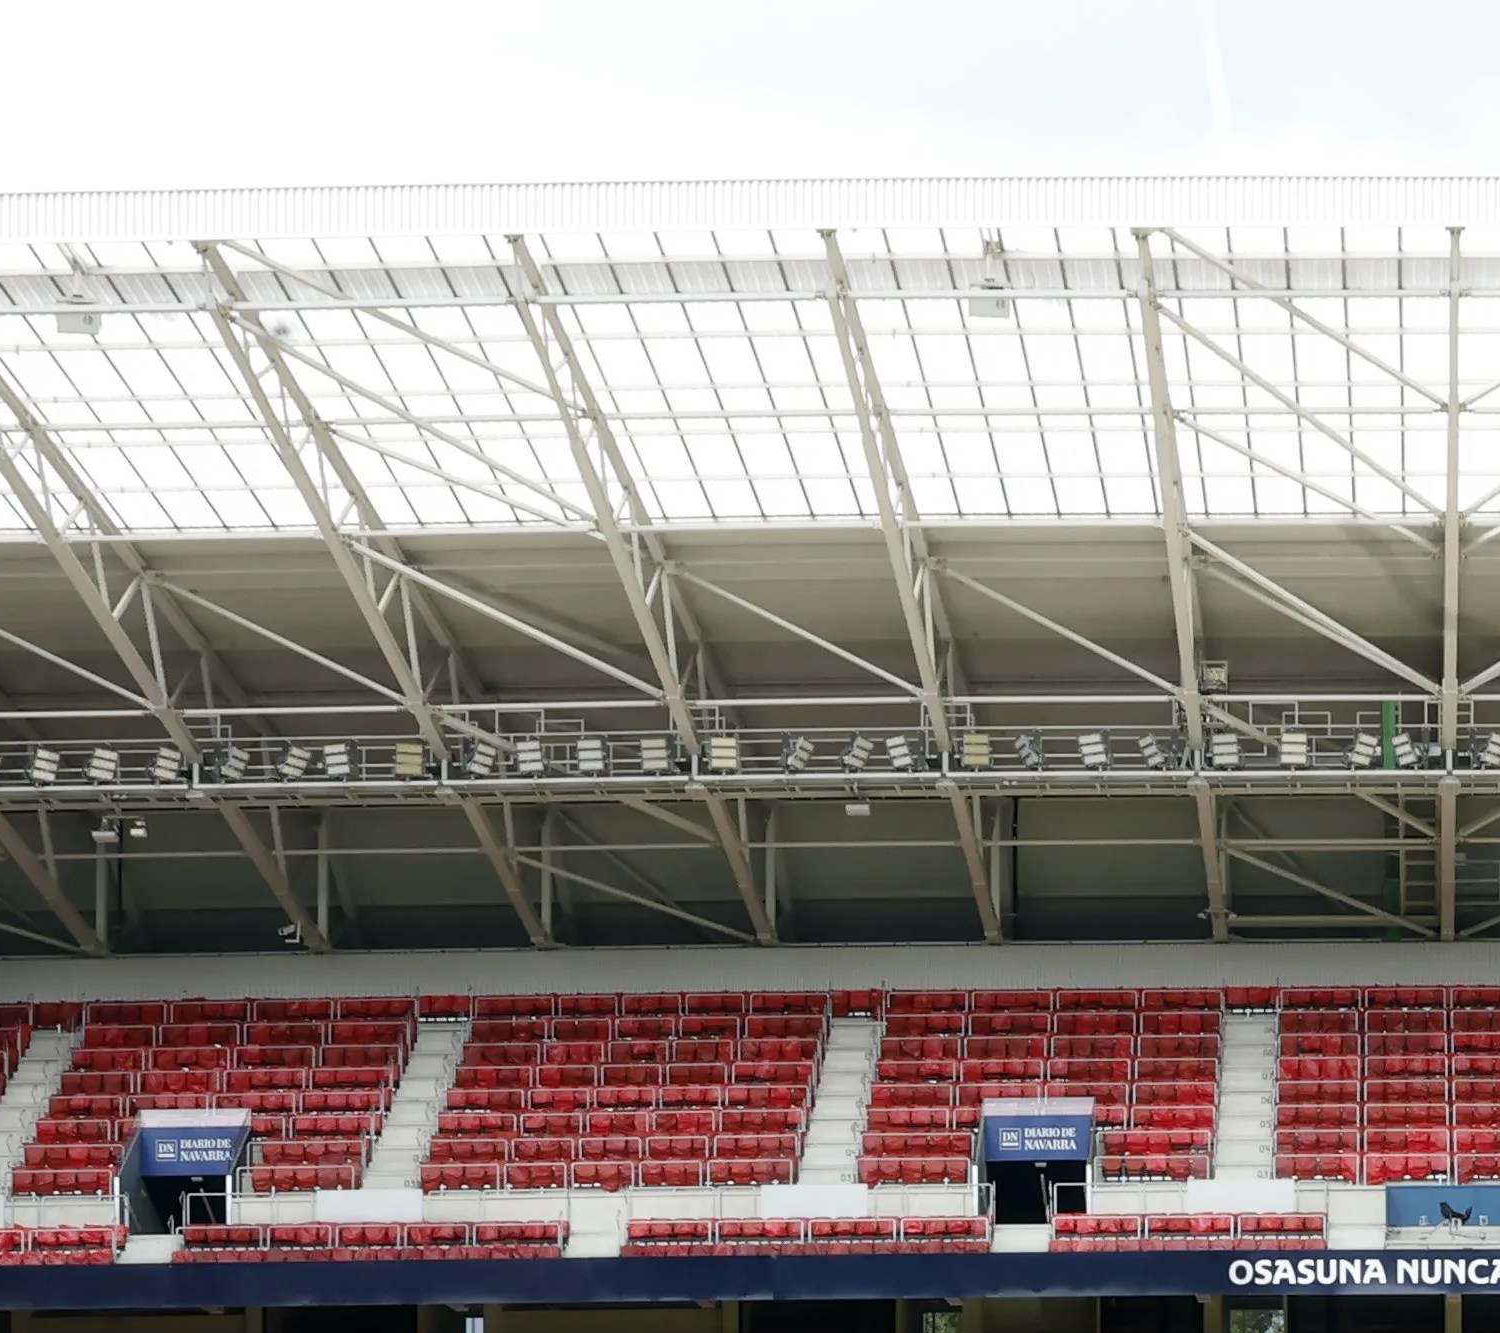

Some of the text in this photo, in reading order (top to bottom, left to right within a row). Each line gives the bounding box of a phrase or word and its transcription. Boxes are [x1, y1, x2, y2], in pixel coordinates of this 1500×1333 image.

[1024, 1126, 1061, 1136] DIARIO
[180, 1138, 231, 1149] DIARIO DE
[1024, 1139, 1076, 1150] NAVARRA
[180, 1150, 232, 1160] NAVARRA
[1229, 1259, 1387, 1285] OSASUNA
